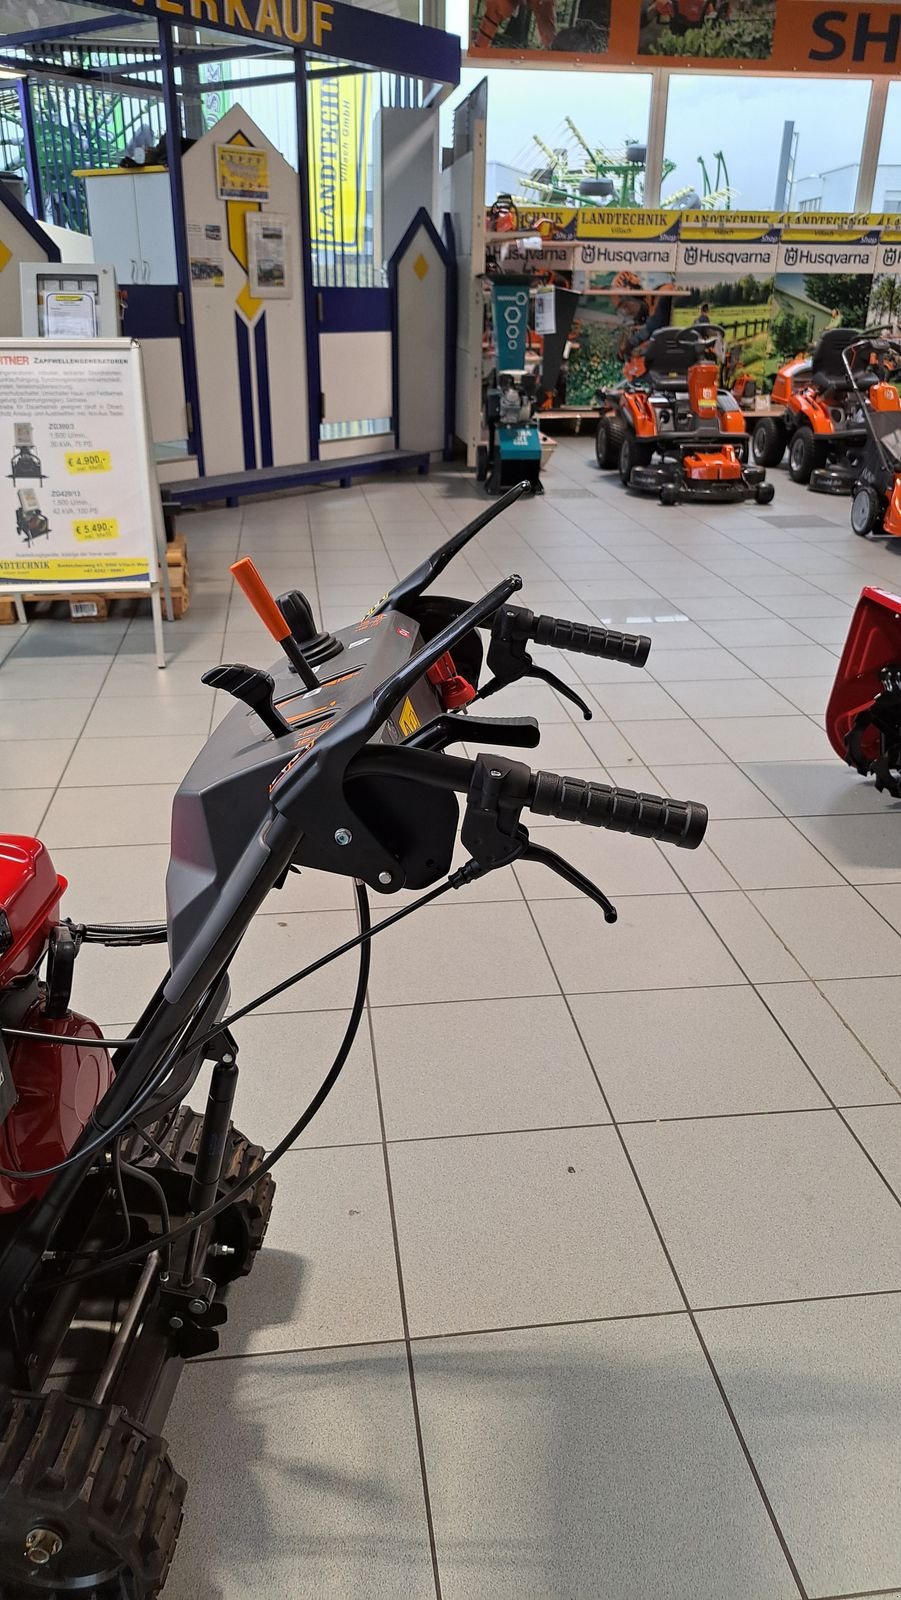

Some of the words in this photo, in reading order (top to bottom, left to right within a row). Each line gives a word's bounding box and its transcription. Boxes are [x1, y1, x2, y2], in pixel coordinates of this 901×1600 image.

[582, 212, 668, 226] LANDTECHNIK
[760, 234, 778, 243] Shop
[860, 236, 877, 244] Shop
[597, 248, 669, 264] Husqvarna
[699, 249, 770, 265] Husqvarna
[799, 250, 870, 266] Husqvarna
